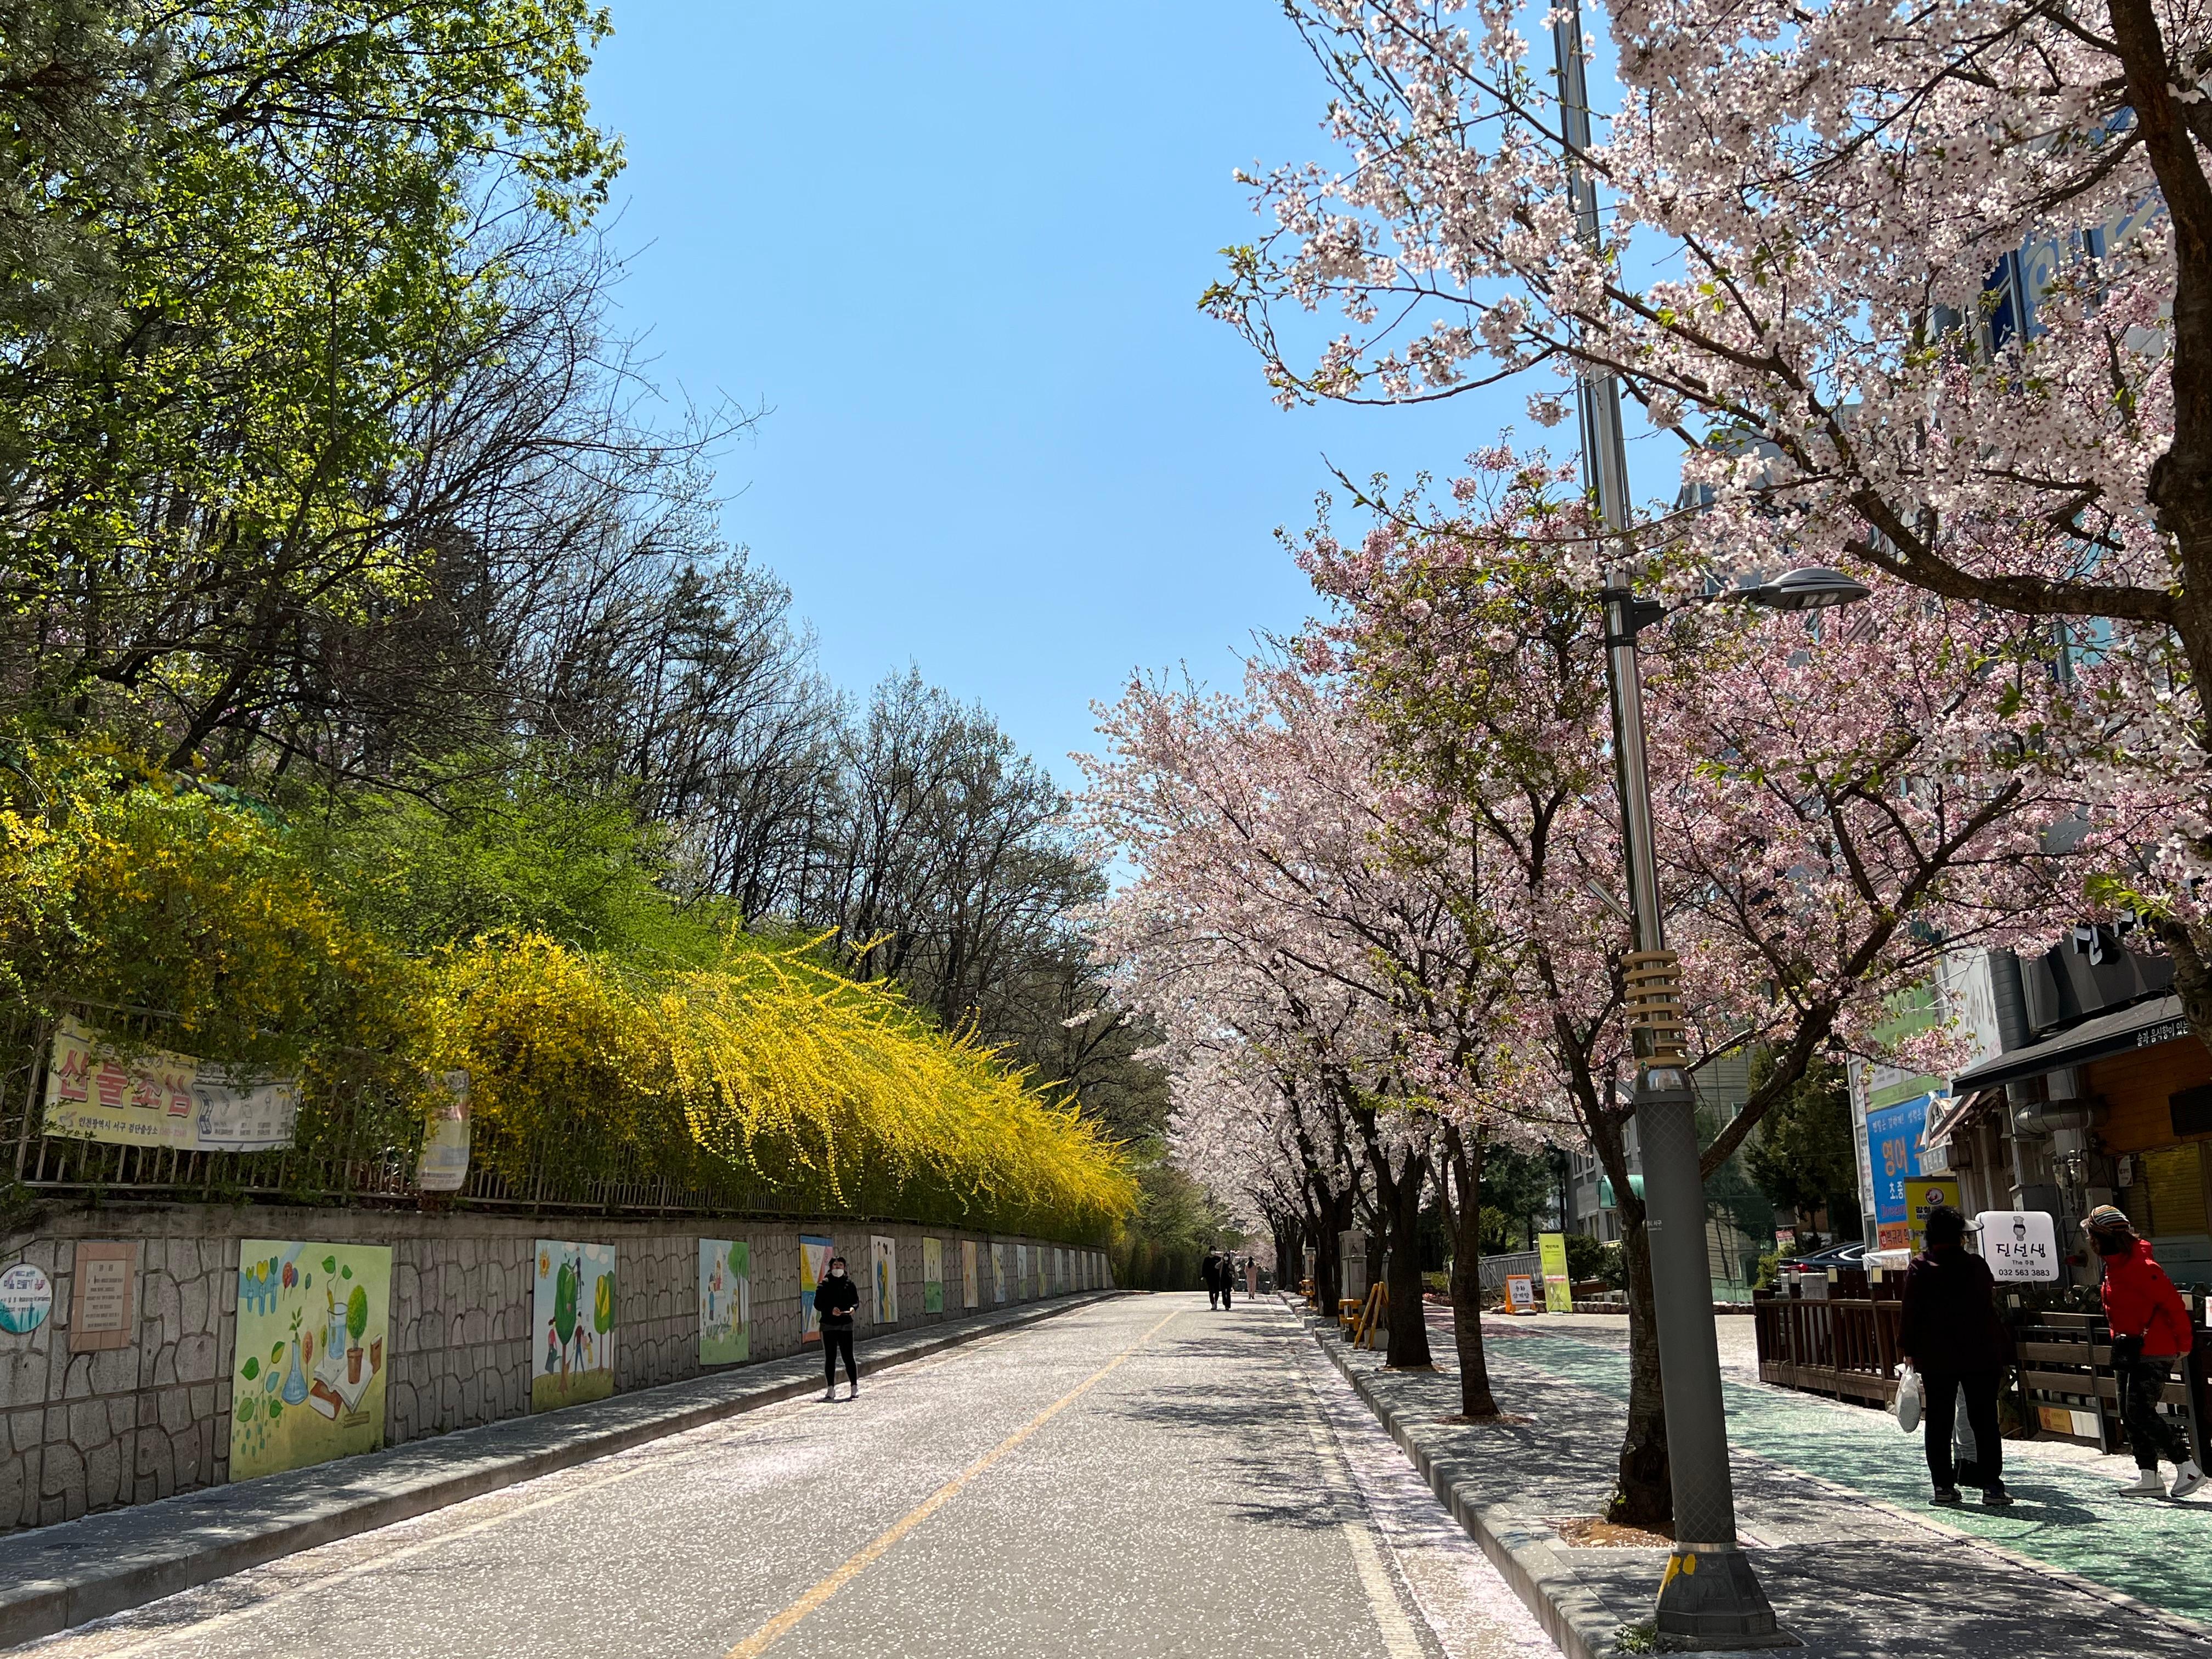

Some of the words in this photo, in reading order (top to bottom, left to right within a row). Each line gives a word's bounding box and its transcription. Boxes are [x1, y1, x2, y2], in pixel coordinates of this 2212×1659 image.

[2137, 1030, 2149, 1047] 술과
[2150, 1023, 2175, 1043] 음식향이
[2176, 1020, 2188, 1036] 있는
[59, 1049, 192, 1118] 산불조심
[78, 1116, 110, 1130] 인천광역시
[113, 1120, 126, 1133] 서구
[1882, 1136, 1909, 1177] 영어
[1996, 1243, 2046, 1258] 진선생
